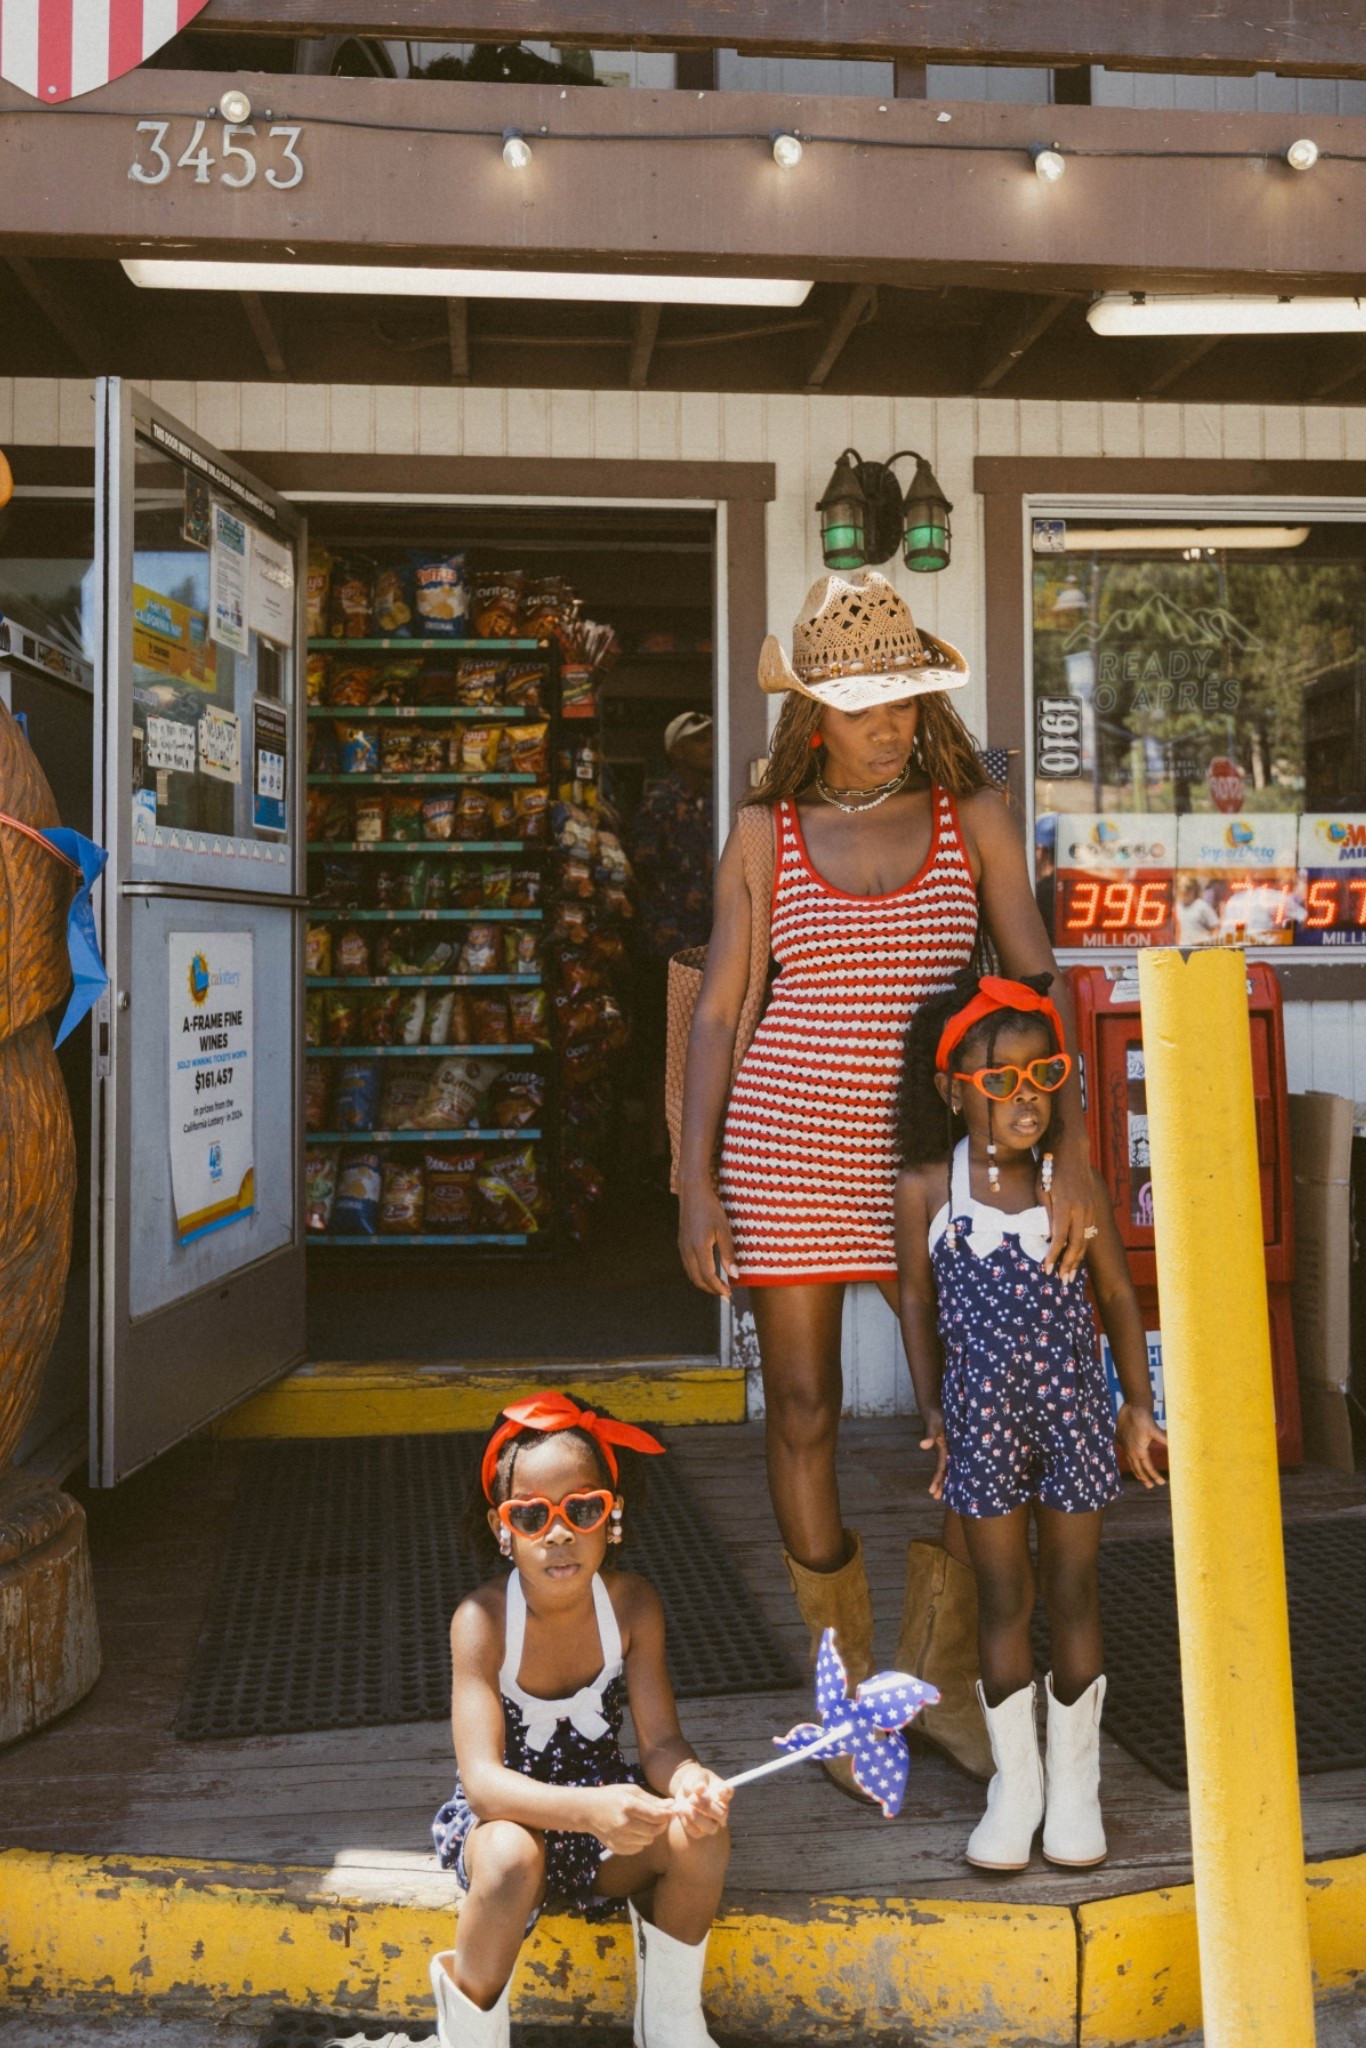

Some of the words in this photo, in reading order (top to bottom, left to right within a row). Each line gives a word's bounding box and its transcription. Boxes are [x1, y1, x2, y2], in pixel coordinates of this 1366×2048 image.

[128, 121, 304, 190] 3453
[165, 431, 179, 451] DOOR
[1098, 649, 1213, 682] READY
[1041, 699, 1080, 775] 1910
[1066, 882, 1168, 929] 396
[1083, 932, 1151, 947] MILLION
[182, 1013, 223, 1033] A-FRAME
[223, 1010, 243, 1027] FINE
[199, 1033, 228, 1052] WINES
[194, 1067, 234, 1094] $161,457
[199, 1103, 213, 1118] prizes
[214, 1100, 225, 1113] from
[225, 1098, 234, 1109] the
[183, 1118, 207, 1134] California
[231, 1110, 243, 1121] 2024
